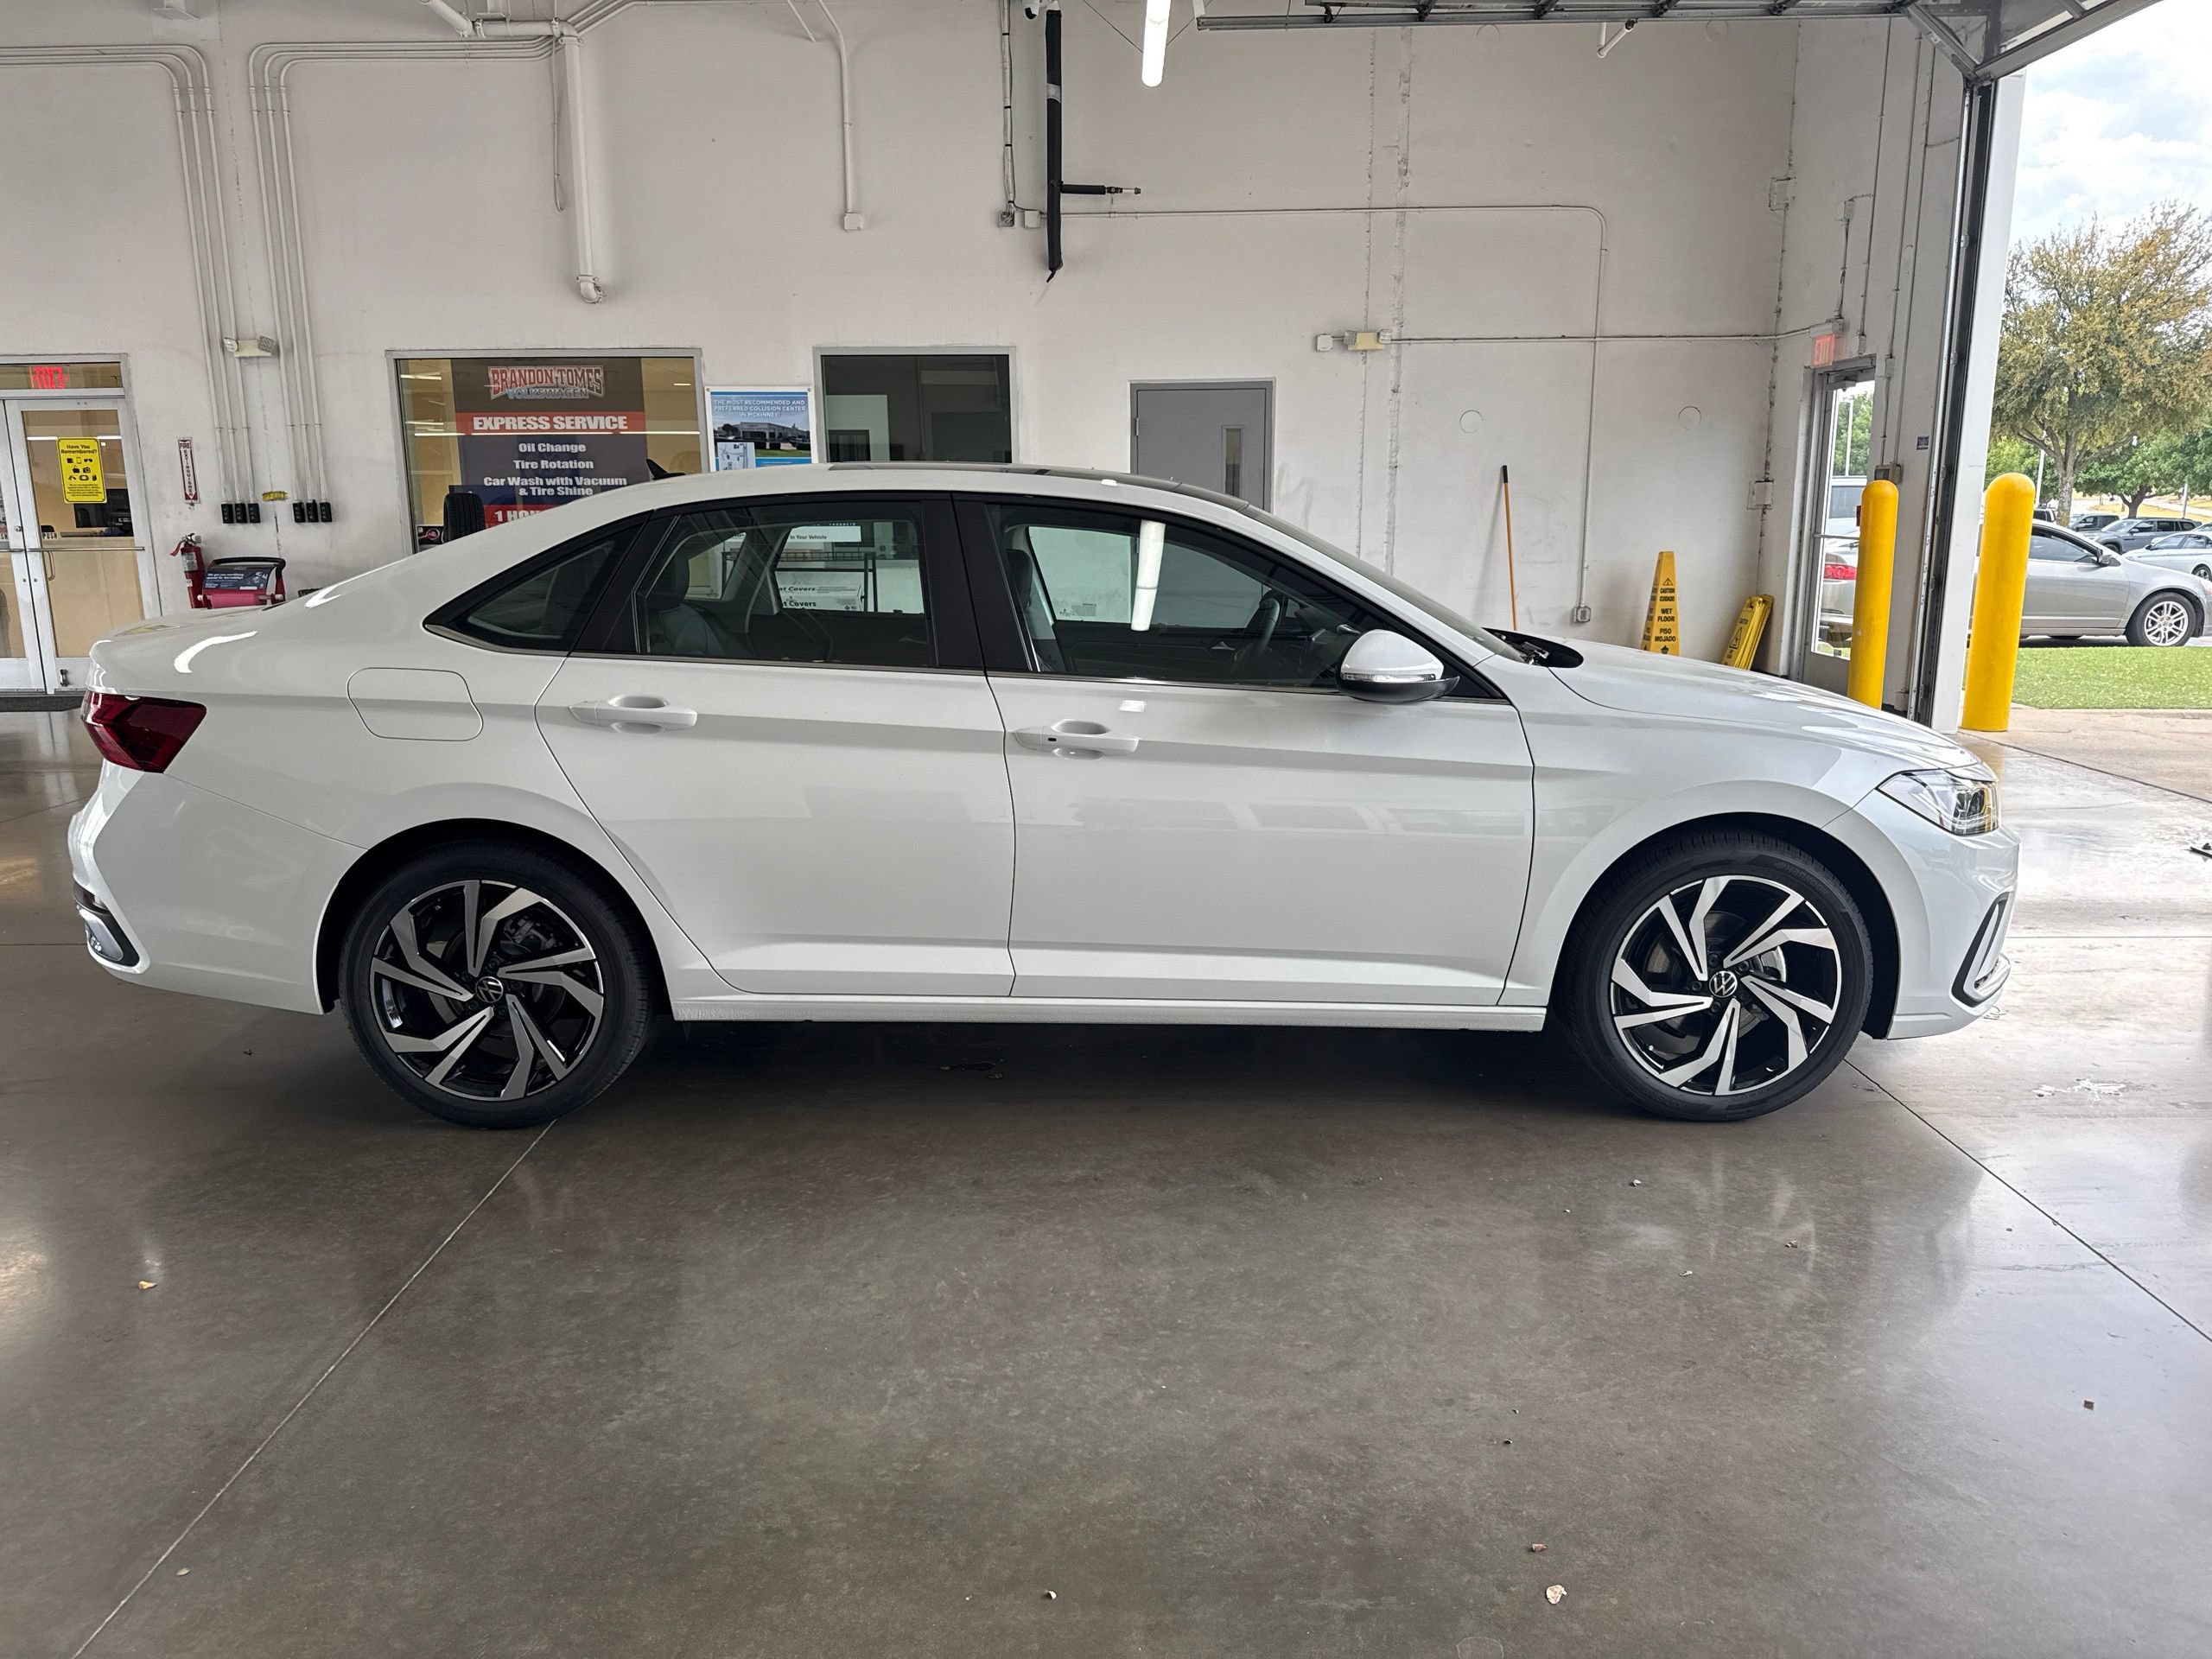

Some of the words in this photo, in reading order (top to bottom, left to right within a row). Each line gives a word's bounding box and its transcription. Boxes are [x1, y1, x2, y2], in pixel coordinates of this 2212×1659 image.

[1814, 337, 1830, 365] EXIT
[491, 368, 554, 395] BRANDON
[556, 368, 602, 395] TOMES
[507, 388, 588, 398] VOLKSWAGEN
[473, 416, 550, 430] EXPRESS
[552, 416, 628, 430] SERVICE
[518, 442, 536, 453] Oil
[537, 442, 587, 454] Change
[513, 460, 538, 469] Tire
[540, 460, 594, 469] Rotation
[483, 477, 505, 486] Car
[507, 477, 543, 486] Wash
[545, 477, 574, 486] with
[575, 477, 627, 486] Vacuum
[518, 487, 528, 496] &
[530, 486, 555, 496] Tire
[556, 486, 594, 496] Shine
[494, 510, 504, 523] 1
